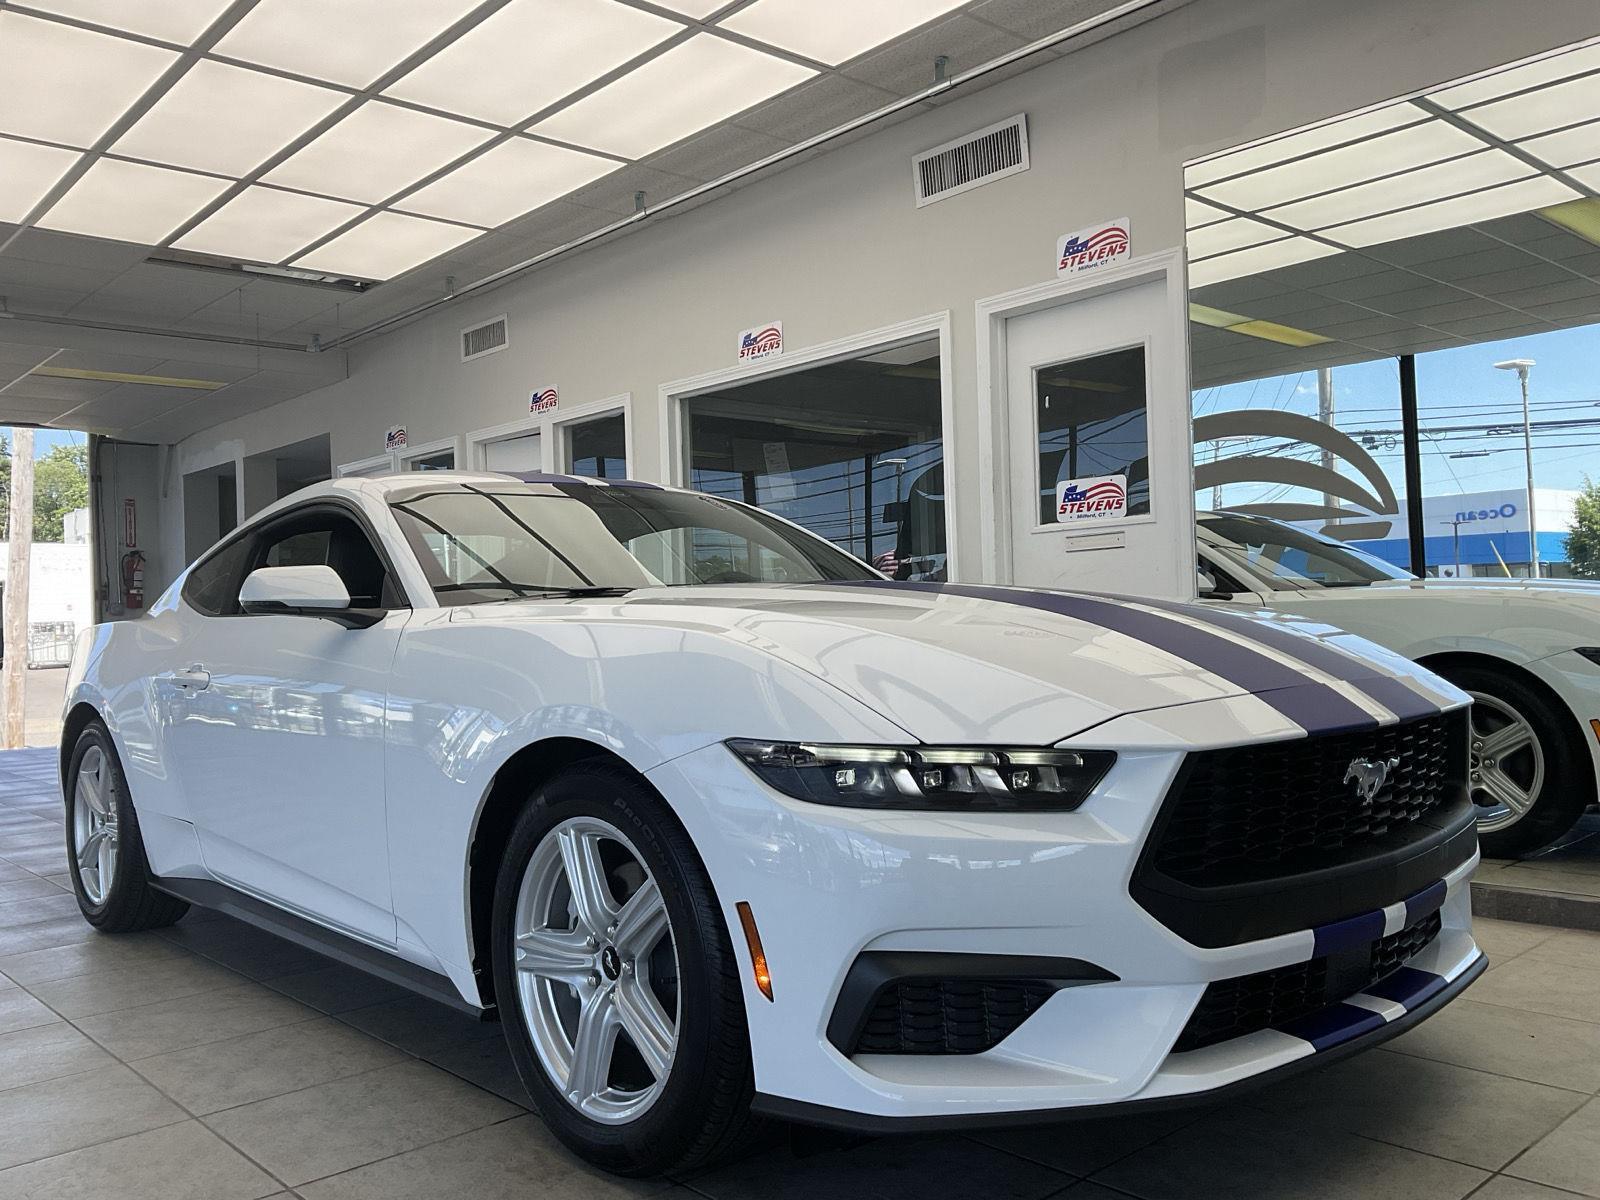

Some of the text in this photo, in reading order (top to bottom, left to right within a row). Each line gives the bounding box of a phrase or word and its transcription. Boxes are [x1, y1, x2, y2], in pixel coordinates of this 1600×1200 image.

[1059, 241, 1128, 270] STEVENS
[740, 339, 781, 359] STEVENS
[530, 399, 557, 413] STEVENS
[1059, 498, 1124, 515] STEVENS
